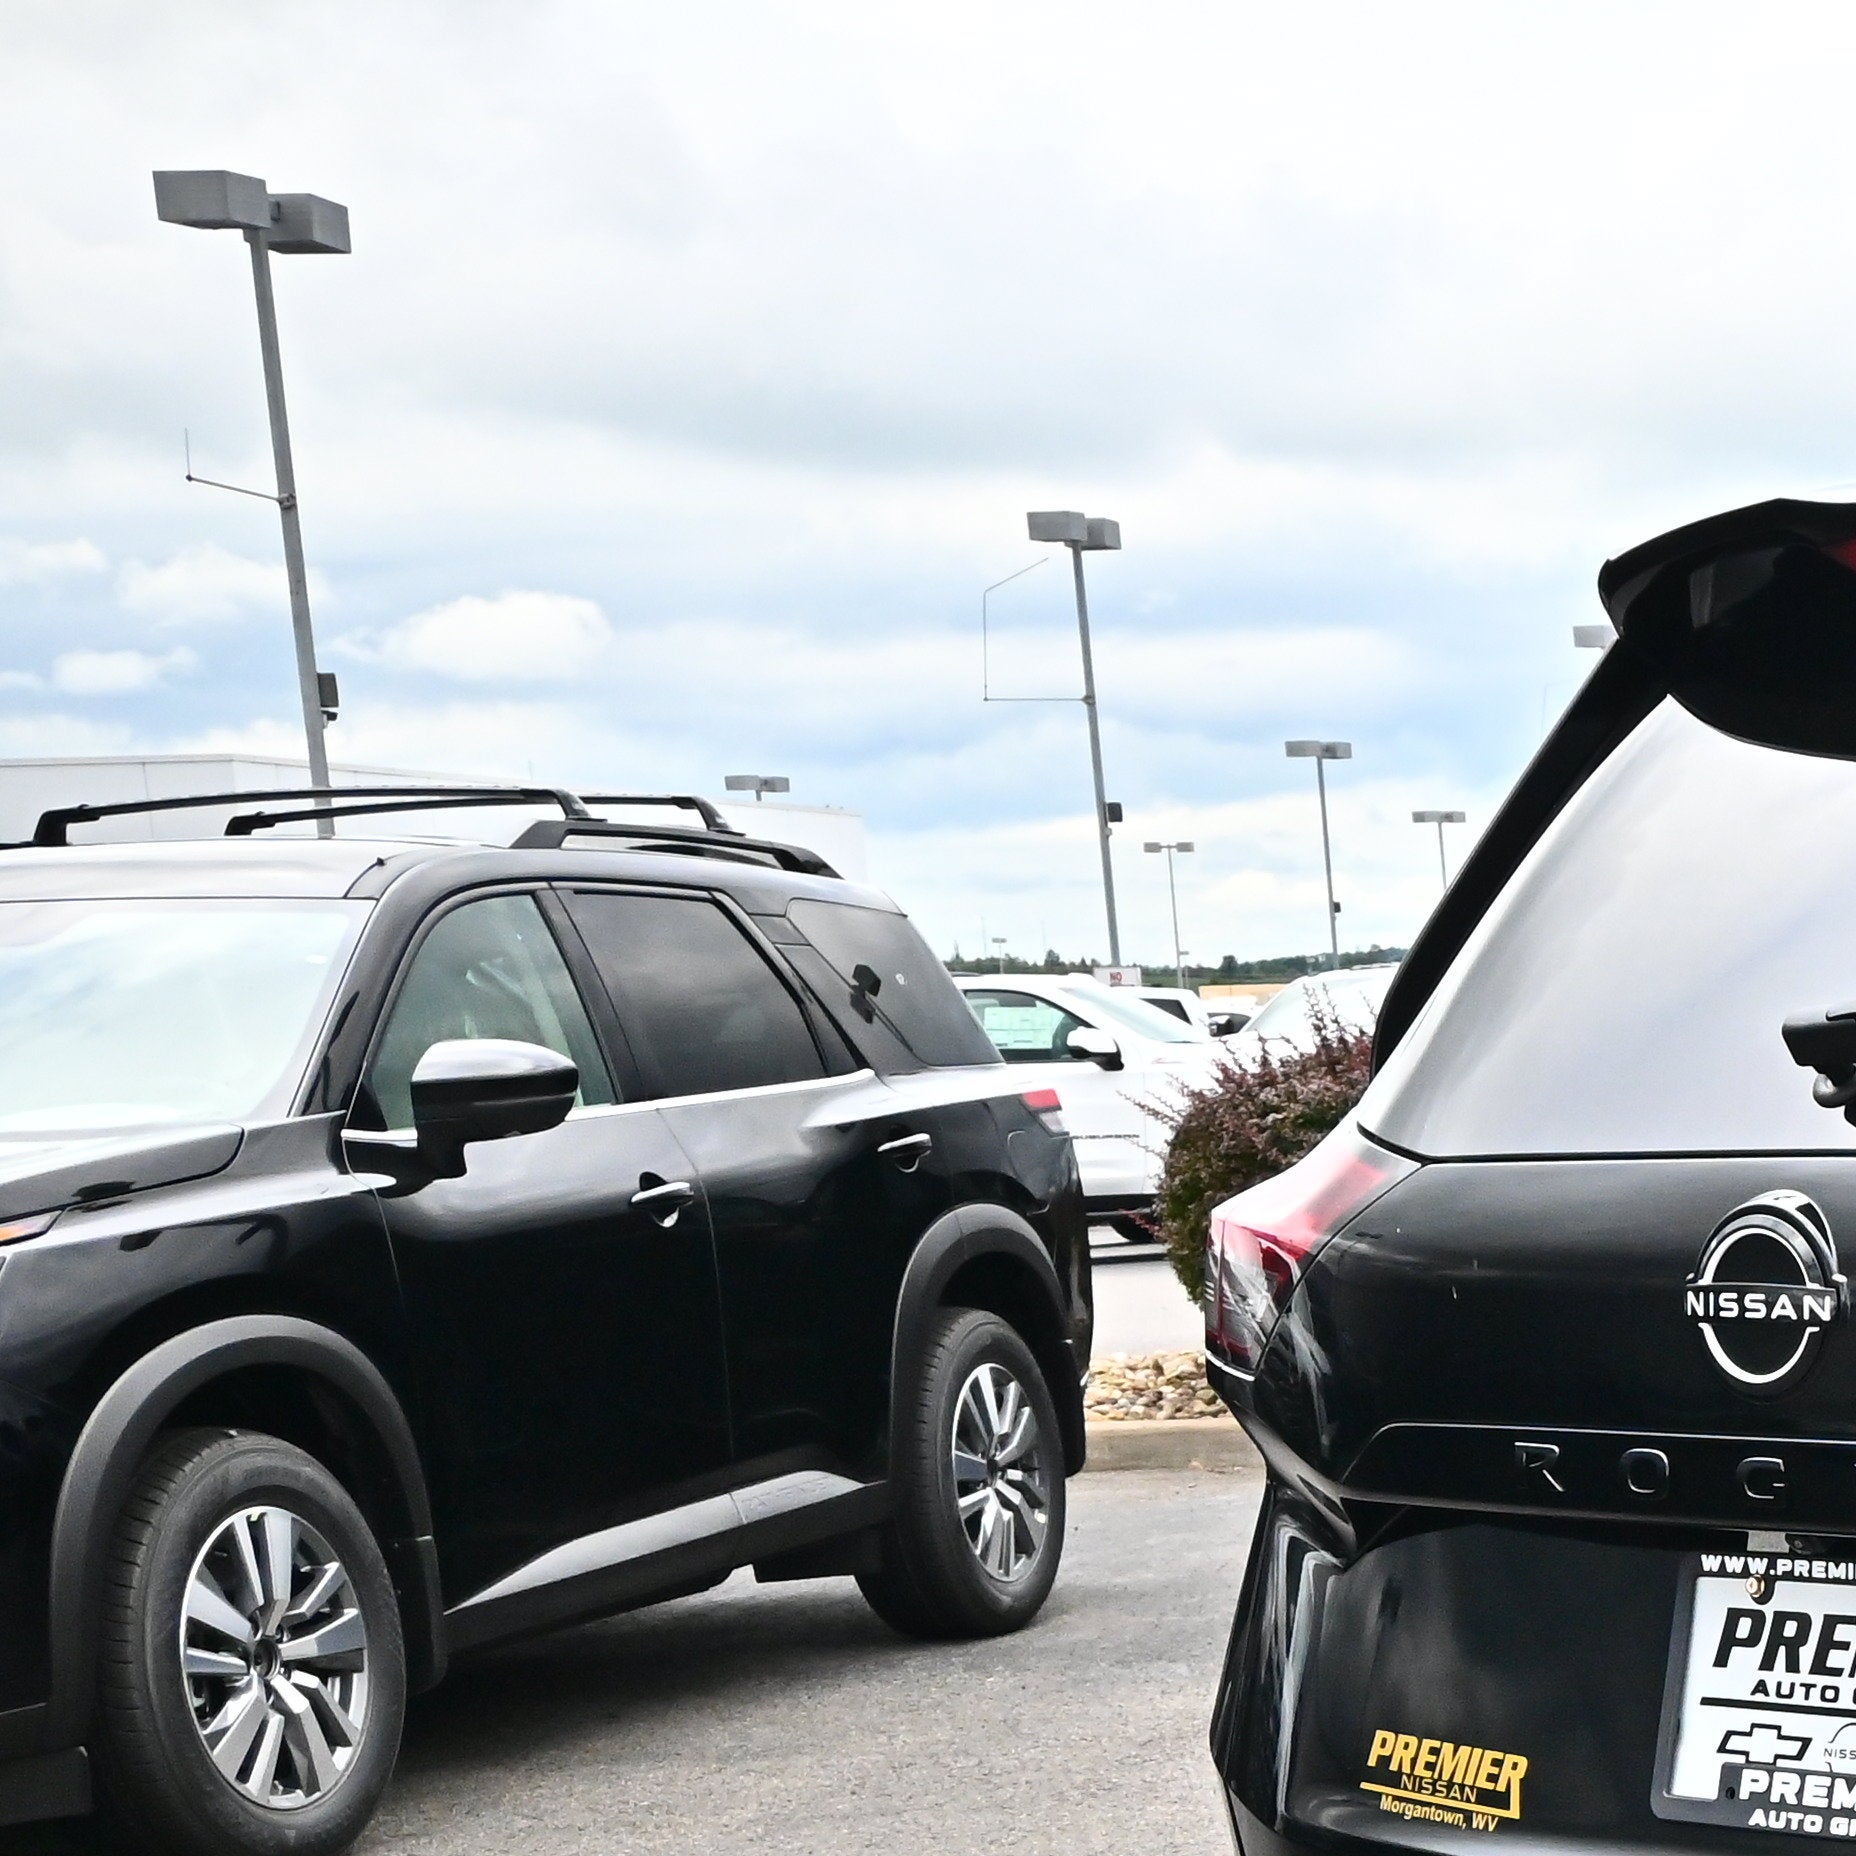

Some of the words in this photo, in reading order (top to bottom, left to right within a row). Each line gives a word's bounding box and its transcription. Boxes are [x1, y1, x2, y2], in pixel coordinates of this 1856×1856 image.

[1686, 1290, 1831, 1322] NISSAN
[1750, 1678, 1840, 1704] AUTO
[1366, 1728, 1529, 1793] PREMIER
[1400, 1774, 1478, 1803] NISSAN
[1380, 1794, 1467, 1830] Morgantown,
[1472, 1811, 1500, 1832] WV
[1748, 1807, 1823, 1834] AUTO
